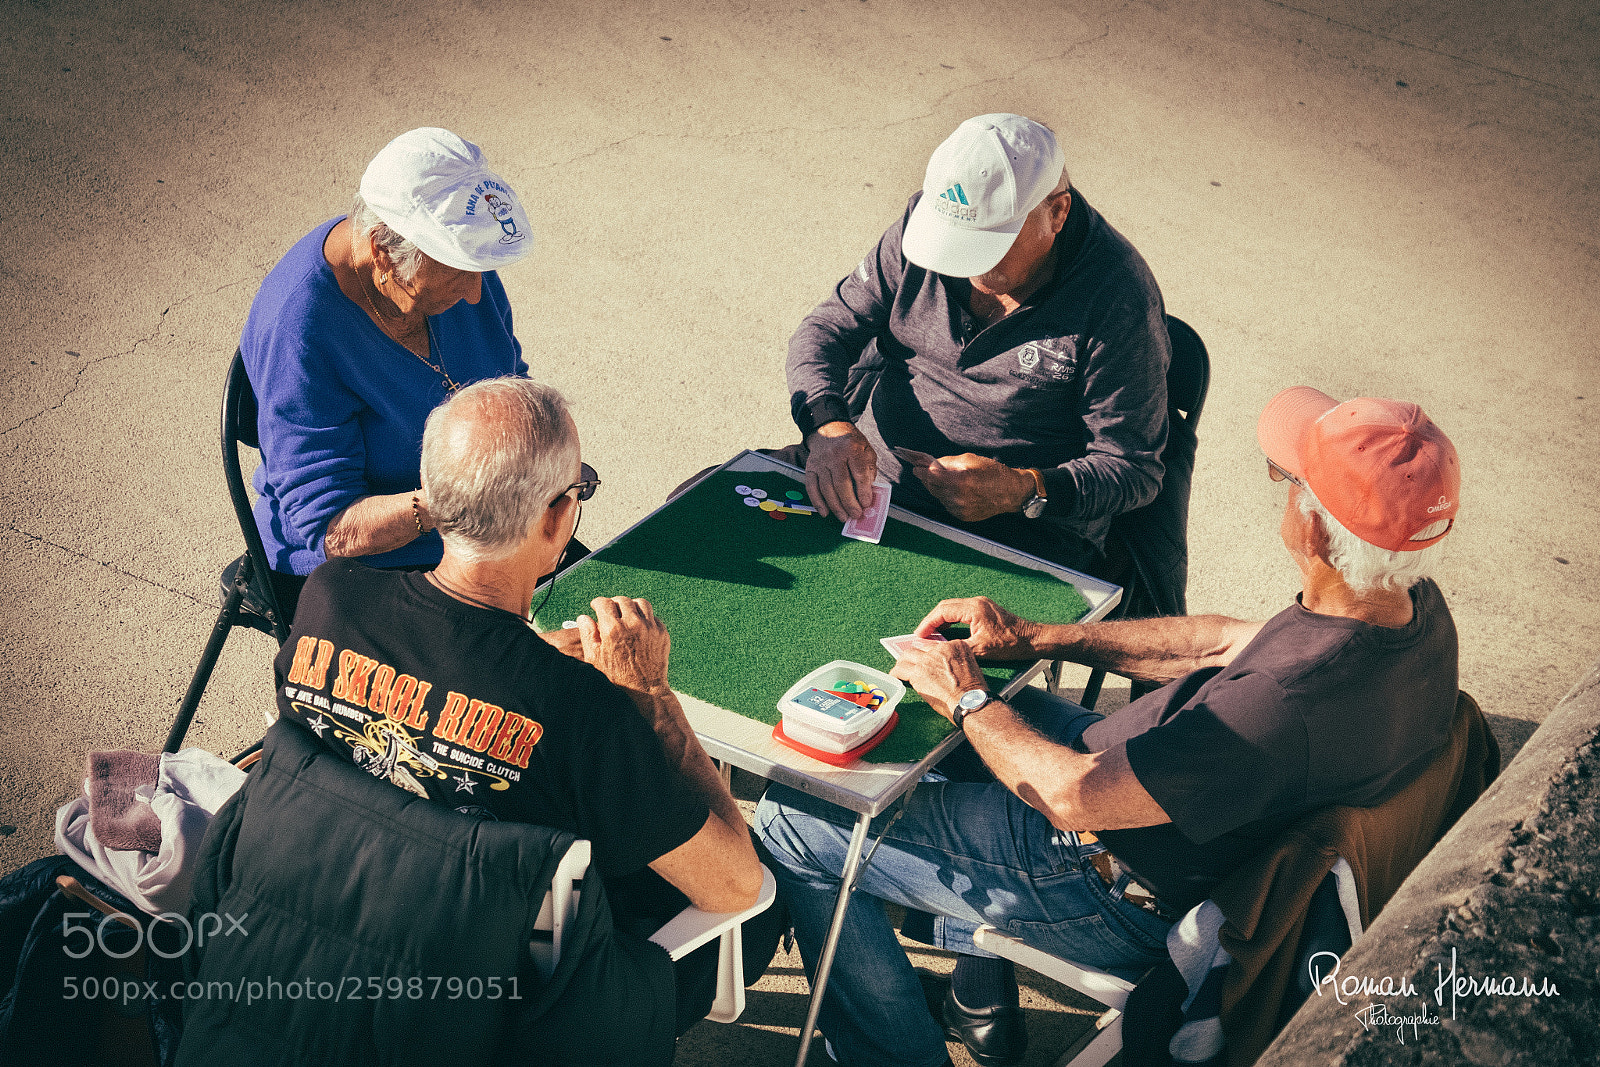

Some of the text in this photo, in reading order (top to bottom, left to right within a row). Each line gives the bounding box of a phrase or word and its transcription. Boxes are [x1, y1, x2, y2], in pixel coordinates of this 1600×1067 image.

[331, 649, 433, 731] SKOOL
[432, 691, 544, 769] RIDER
[432, 741, 521, 782] THE SUICIDE CLUTCH
